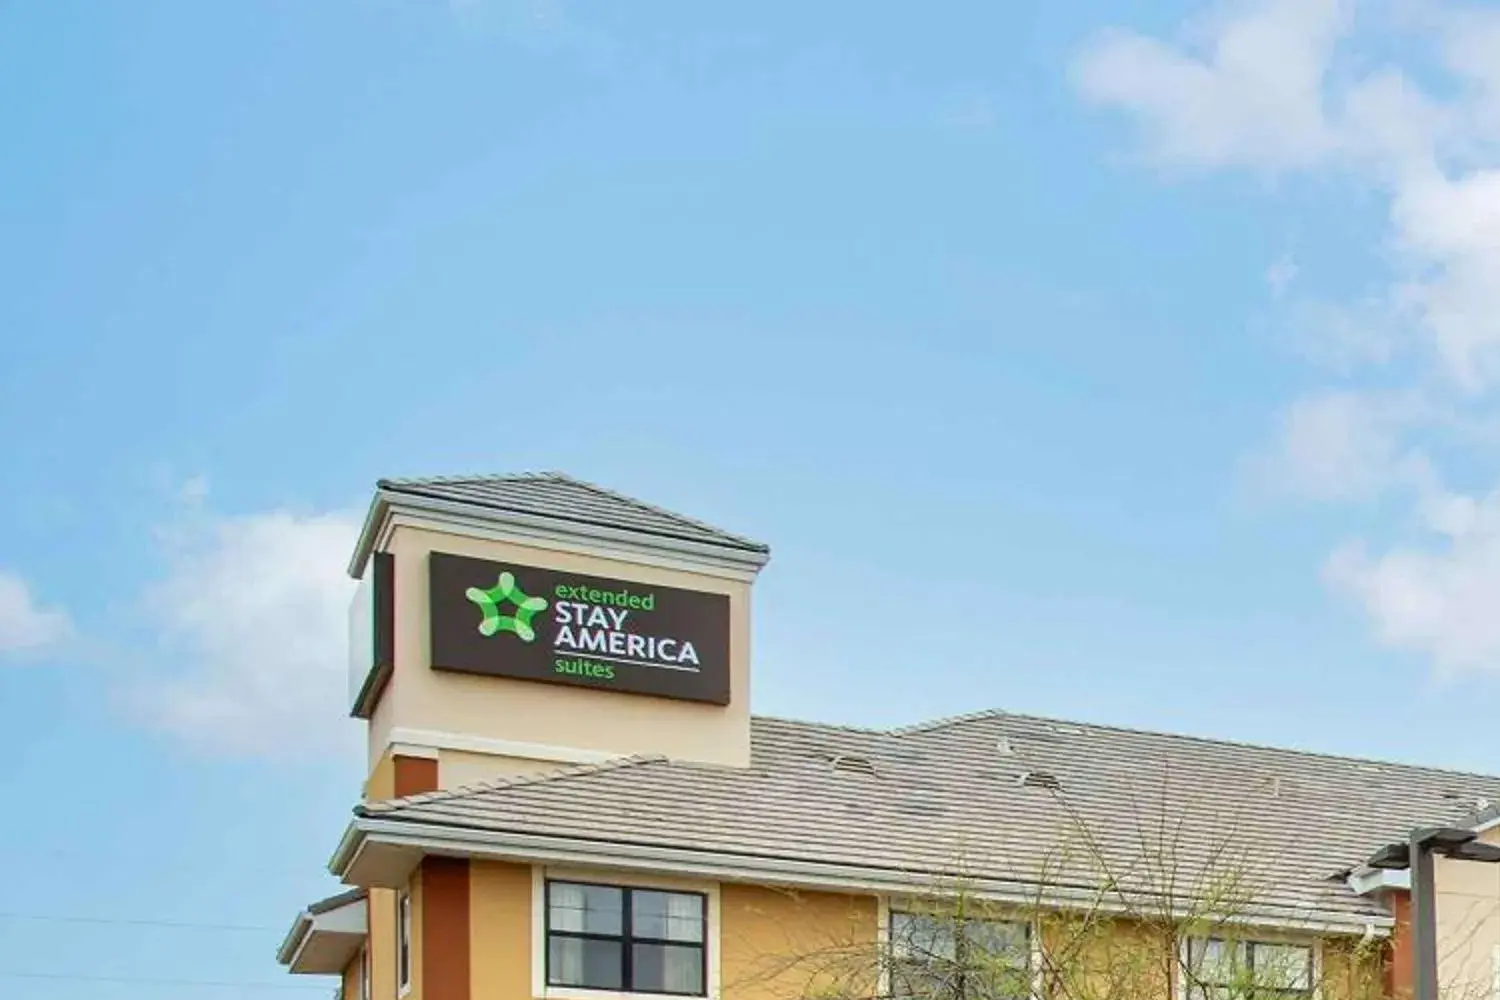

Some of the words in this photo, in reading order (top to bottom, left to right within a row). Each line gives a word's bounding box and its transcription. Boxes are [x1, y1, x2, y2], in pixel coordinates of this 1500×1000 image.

[555, 584, 655, 611] extended
[555, 601, 629, 631] STAY
[554, 625, 700, 665] AMERICA
[555, 658, 615, 679] suites
